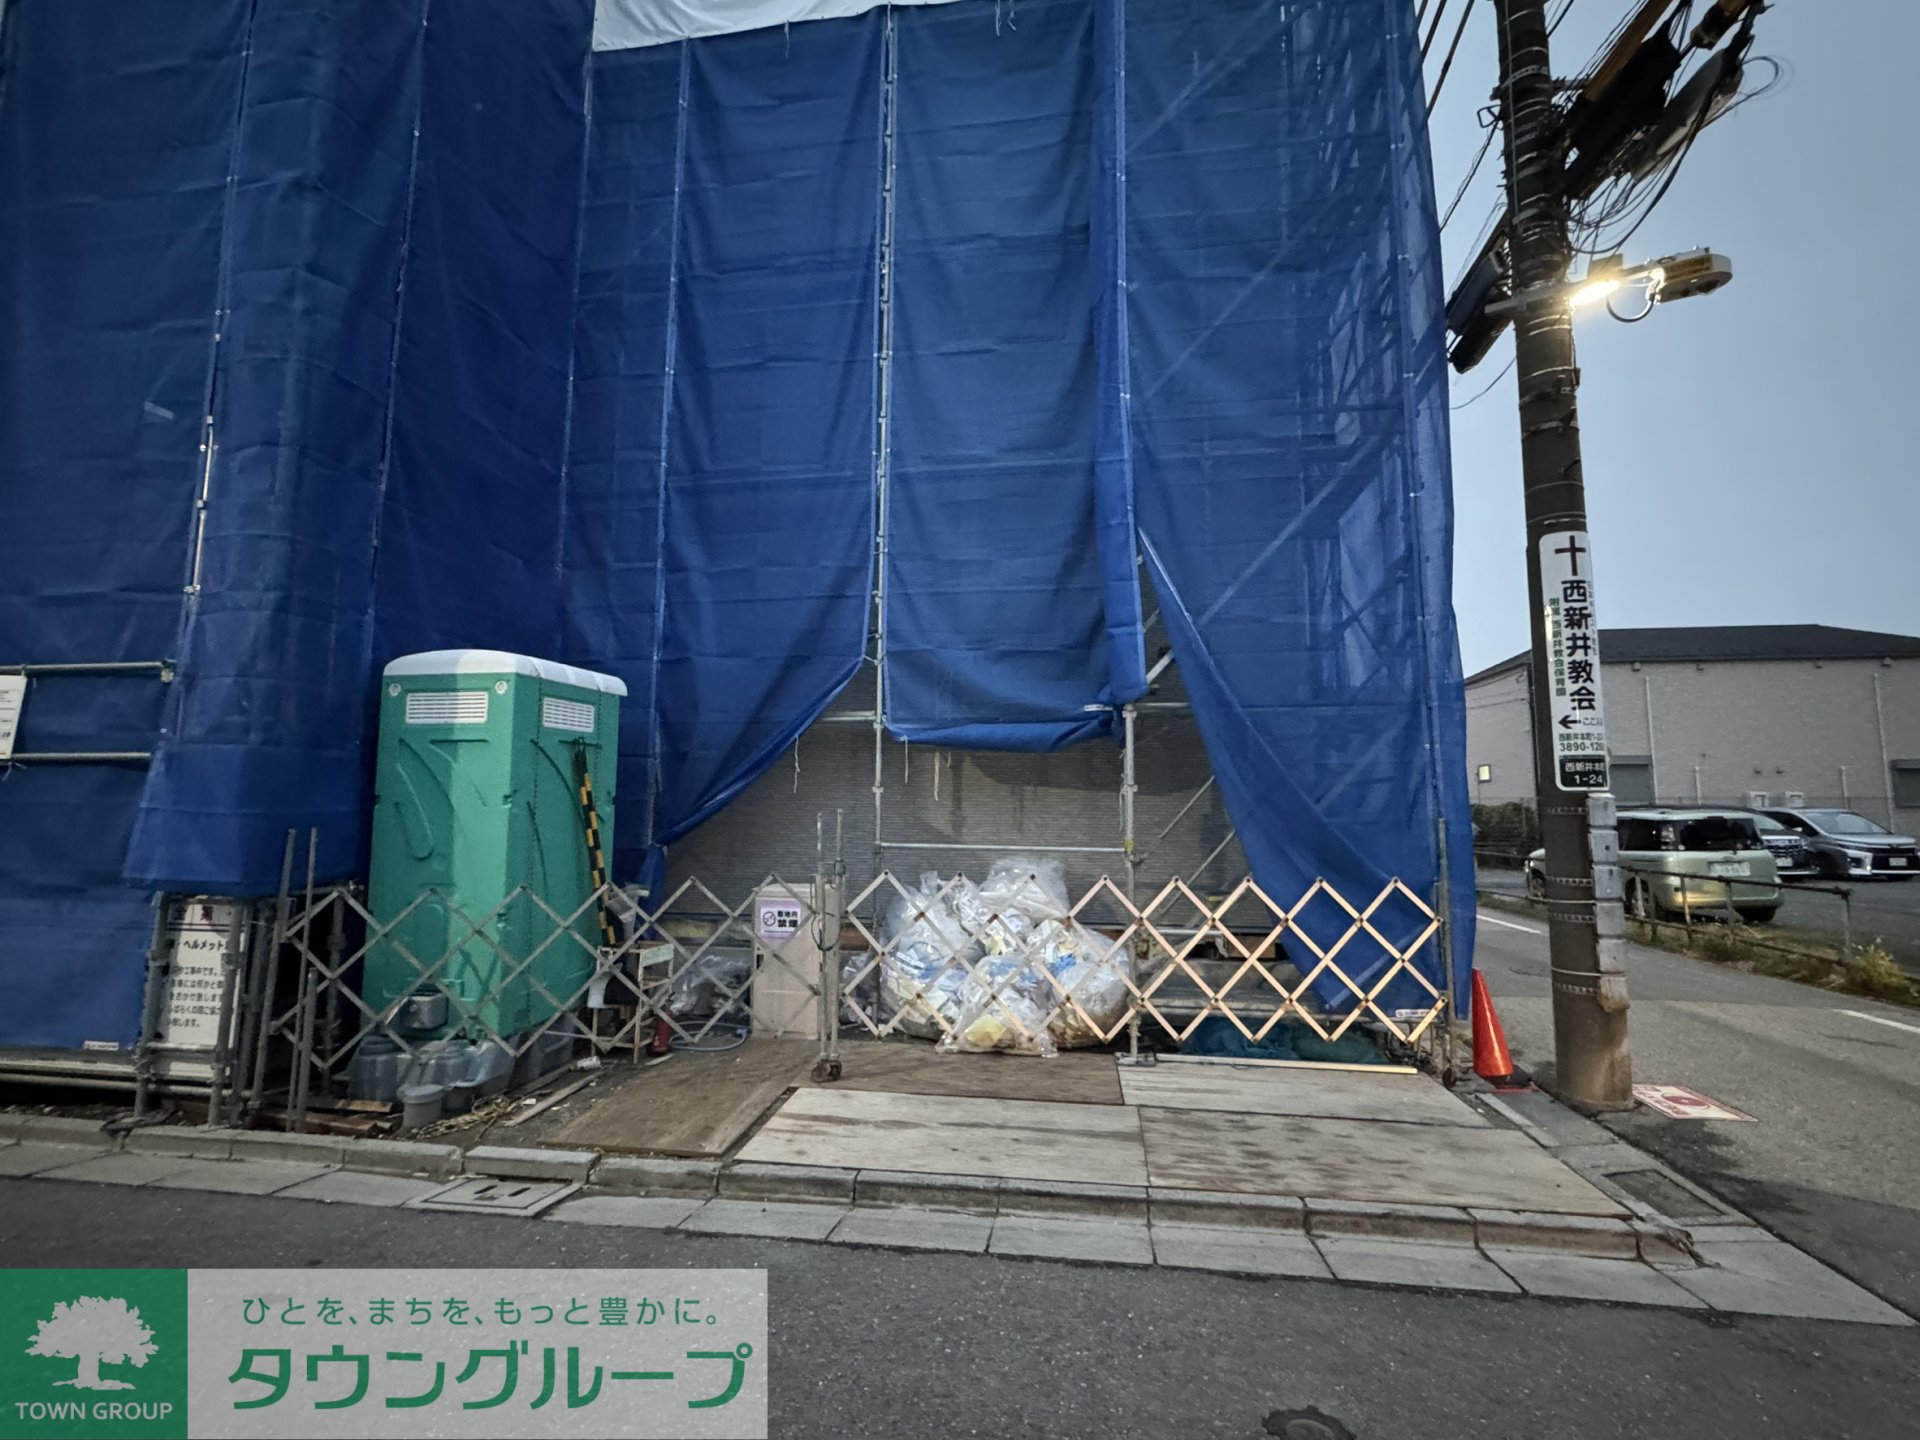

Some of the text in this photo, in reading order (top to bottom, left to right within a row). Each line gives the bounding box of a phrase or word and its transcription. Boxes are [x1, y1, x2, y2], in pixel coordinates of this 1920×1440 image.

[1561, 579, 1596, 712] 西新井教会
[1573, 774, 1603, 785] 1-24
[777, 919, 798, 928] 禁煙
